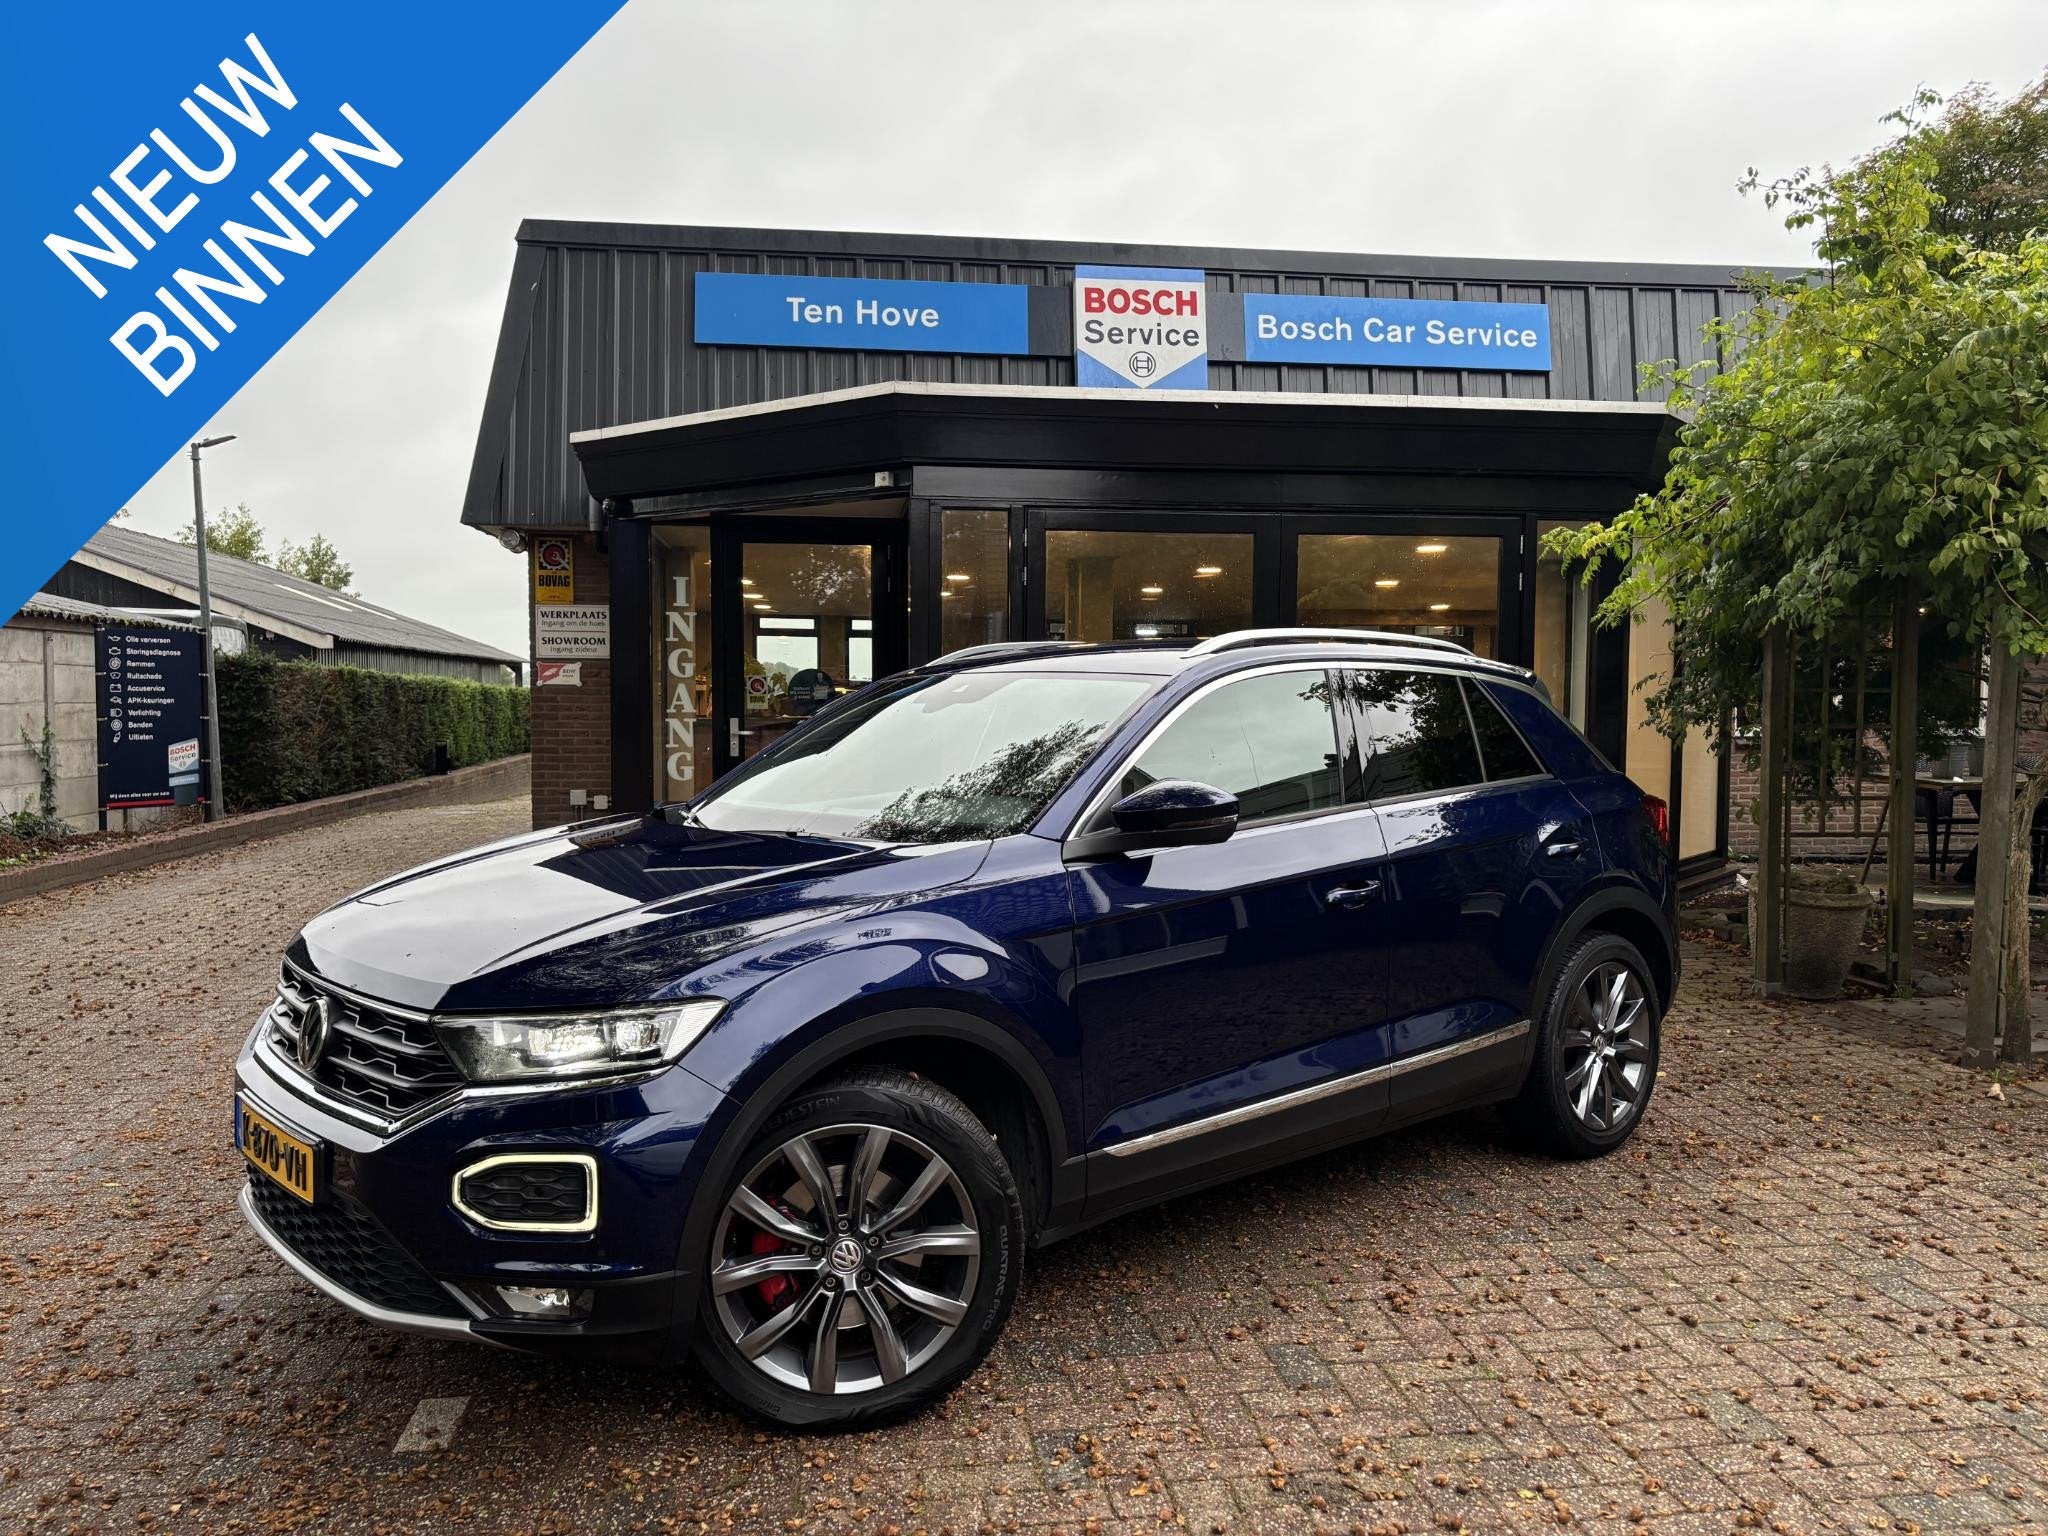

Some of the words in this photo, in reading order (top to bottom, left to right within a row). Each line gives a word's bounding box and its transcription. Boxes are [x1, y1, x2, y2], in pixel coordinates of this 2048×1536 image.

[1084, 287, 1198, 316] BOSCH
[785, 296, 843, 325] Ten
[856, 299, 940, 328] Hove
[1084, 319, 1200, 347] Service
[1257, 314, 1352, 341] Bosch
[1363, 317, 1415, 343] Car
[1426, 319, 1538, 348] Service
[538, 574, 571, 587] BOVAG
[540, 610, 607, 620] WERKPLAATS
[541, 636, 607, 646] SHOWROOM
[126, 647, 182, 657] Storingsdiagnose
[665, 576, 697, 781] INGANG
[127, 684, 166, 692] Accuservice
[127, 697, 175, 705] APK-keuringen
[128, 709, 162, 717] Verlichting
[170, 743, 196, 756] BOSCH
[170, 752, 197, 762] Service
[242, 1110, 307, 1192] K-870-VH
